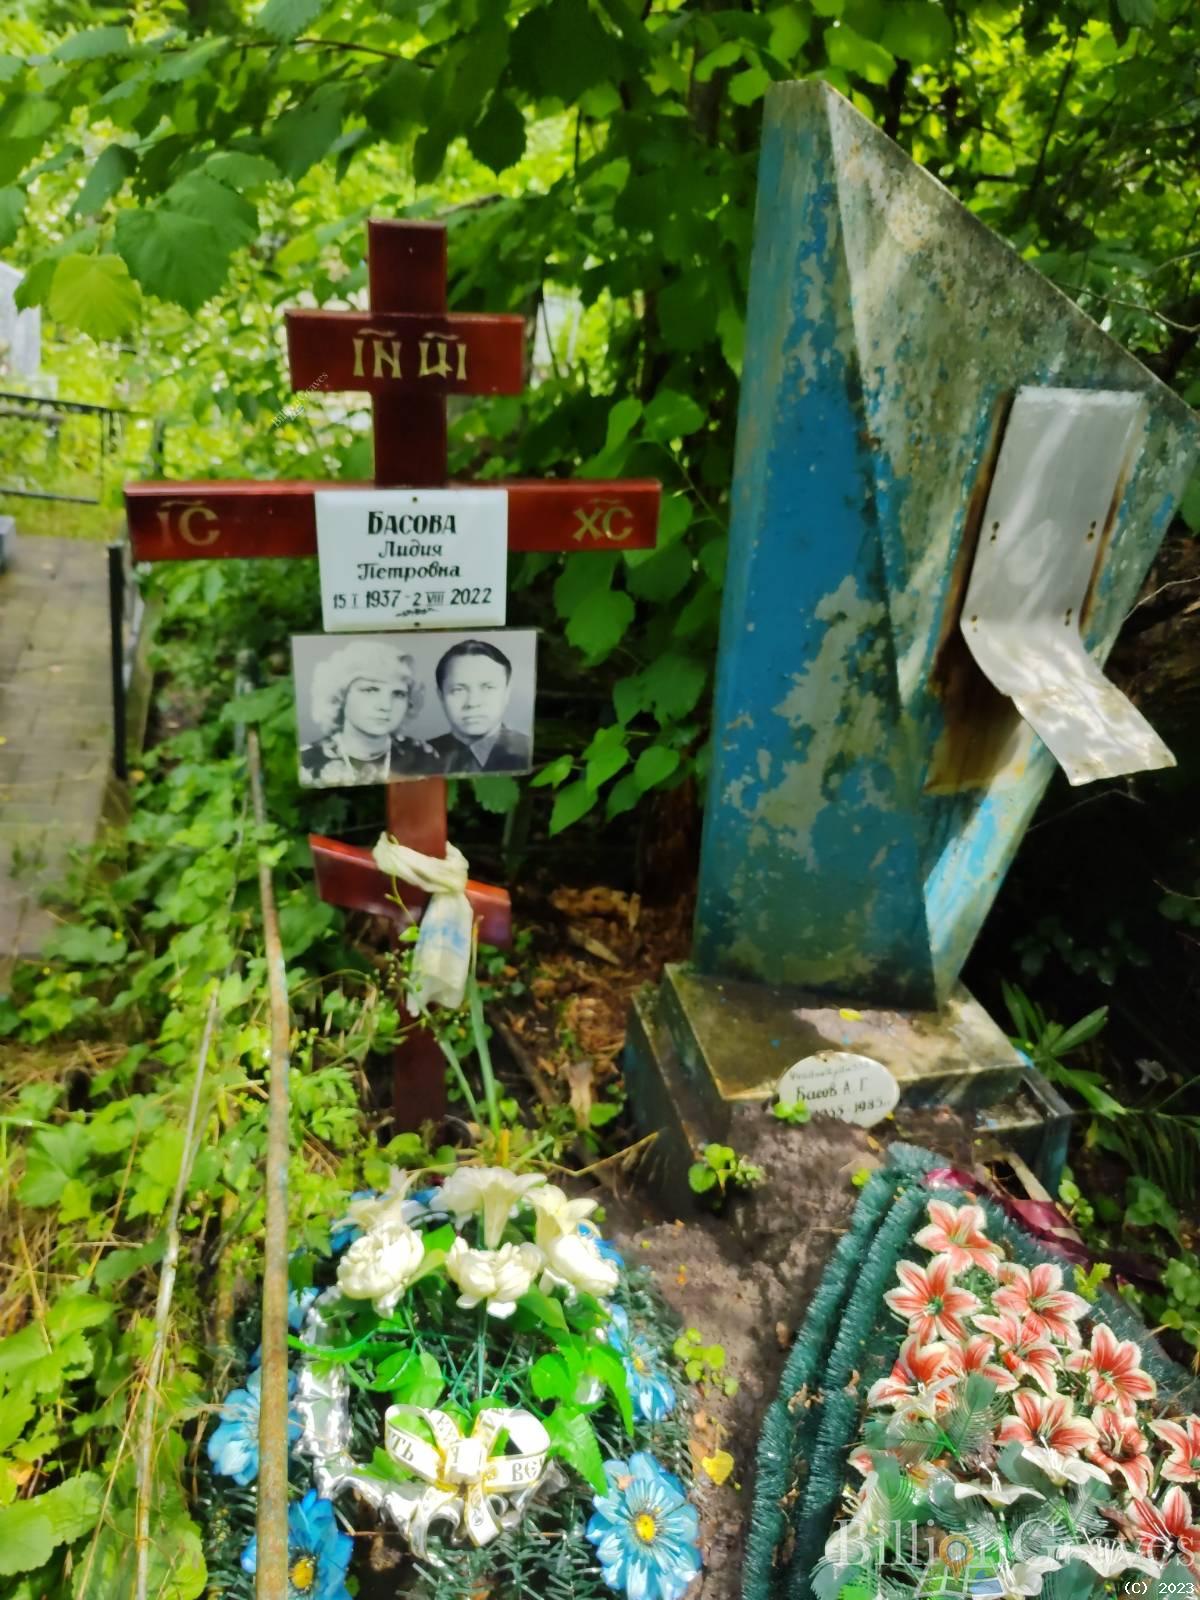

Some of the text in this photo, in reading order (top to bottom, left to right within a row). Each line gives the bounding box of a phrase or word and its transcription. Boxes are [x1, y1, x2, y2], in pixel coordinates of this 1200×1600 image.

[367, 511, 457, 535] БАСОВА
[378, 539, 443, 558] Лидия
[357, 561, 461, 582] Петровна
[333, 594, 347, 609] 15
[365, 590, 401, 608] 1937
[412, 592, 422, 607] 2
[450, 587, 492, 605] 2022
